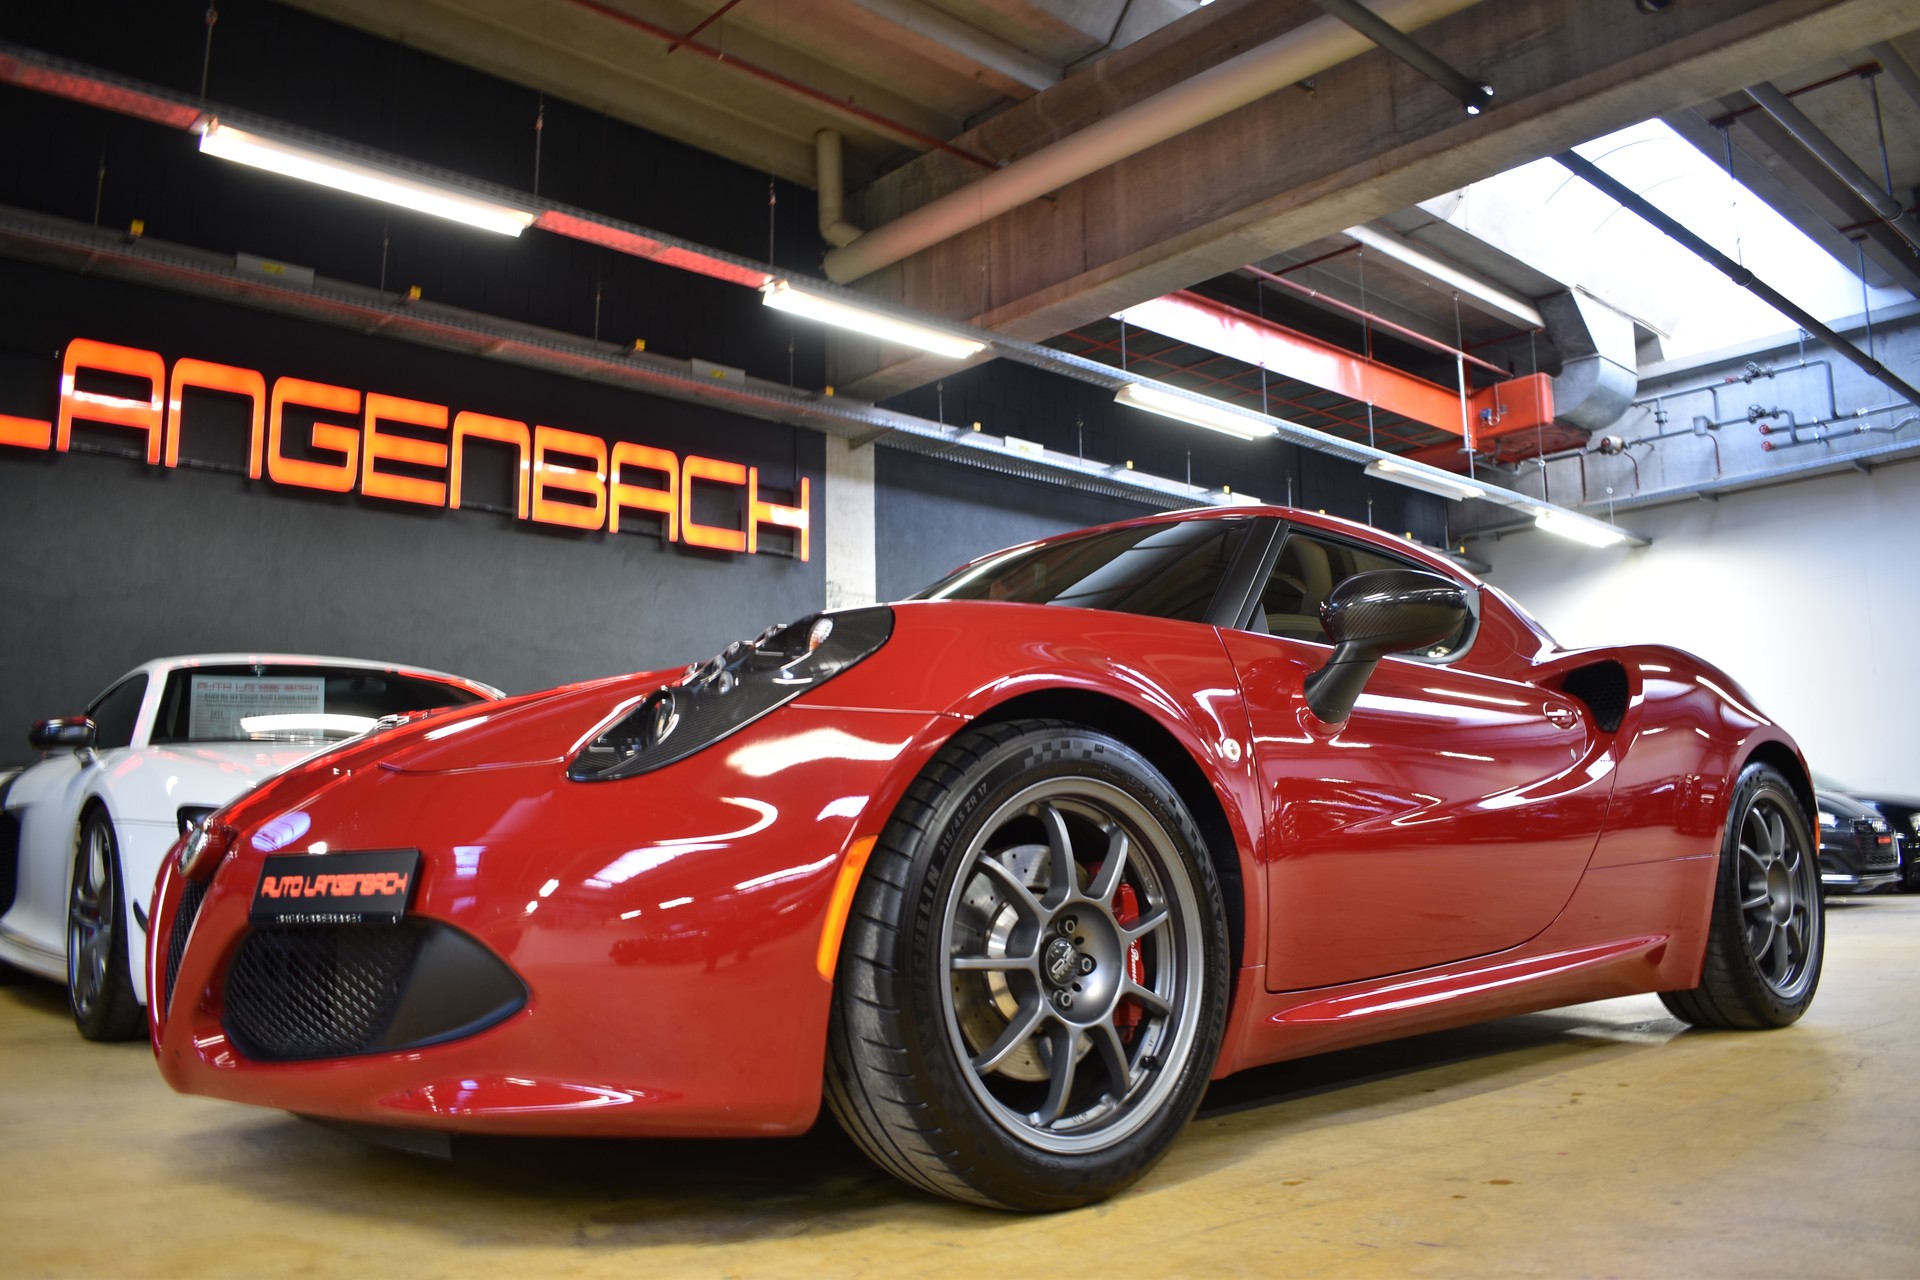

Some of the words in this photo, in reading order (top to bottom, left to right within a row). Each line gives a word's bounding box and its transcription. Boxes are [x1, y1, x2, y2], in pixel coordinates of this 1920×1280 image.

[940, 811, 966, 857] 215/45
[964, 795, 978, 813] ZR
[978, 782, 988, 797] 17
[261, 876, 304, 899] AUTO
[303, 872, 409, 898] LANGENBACH
